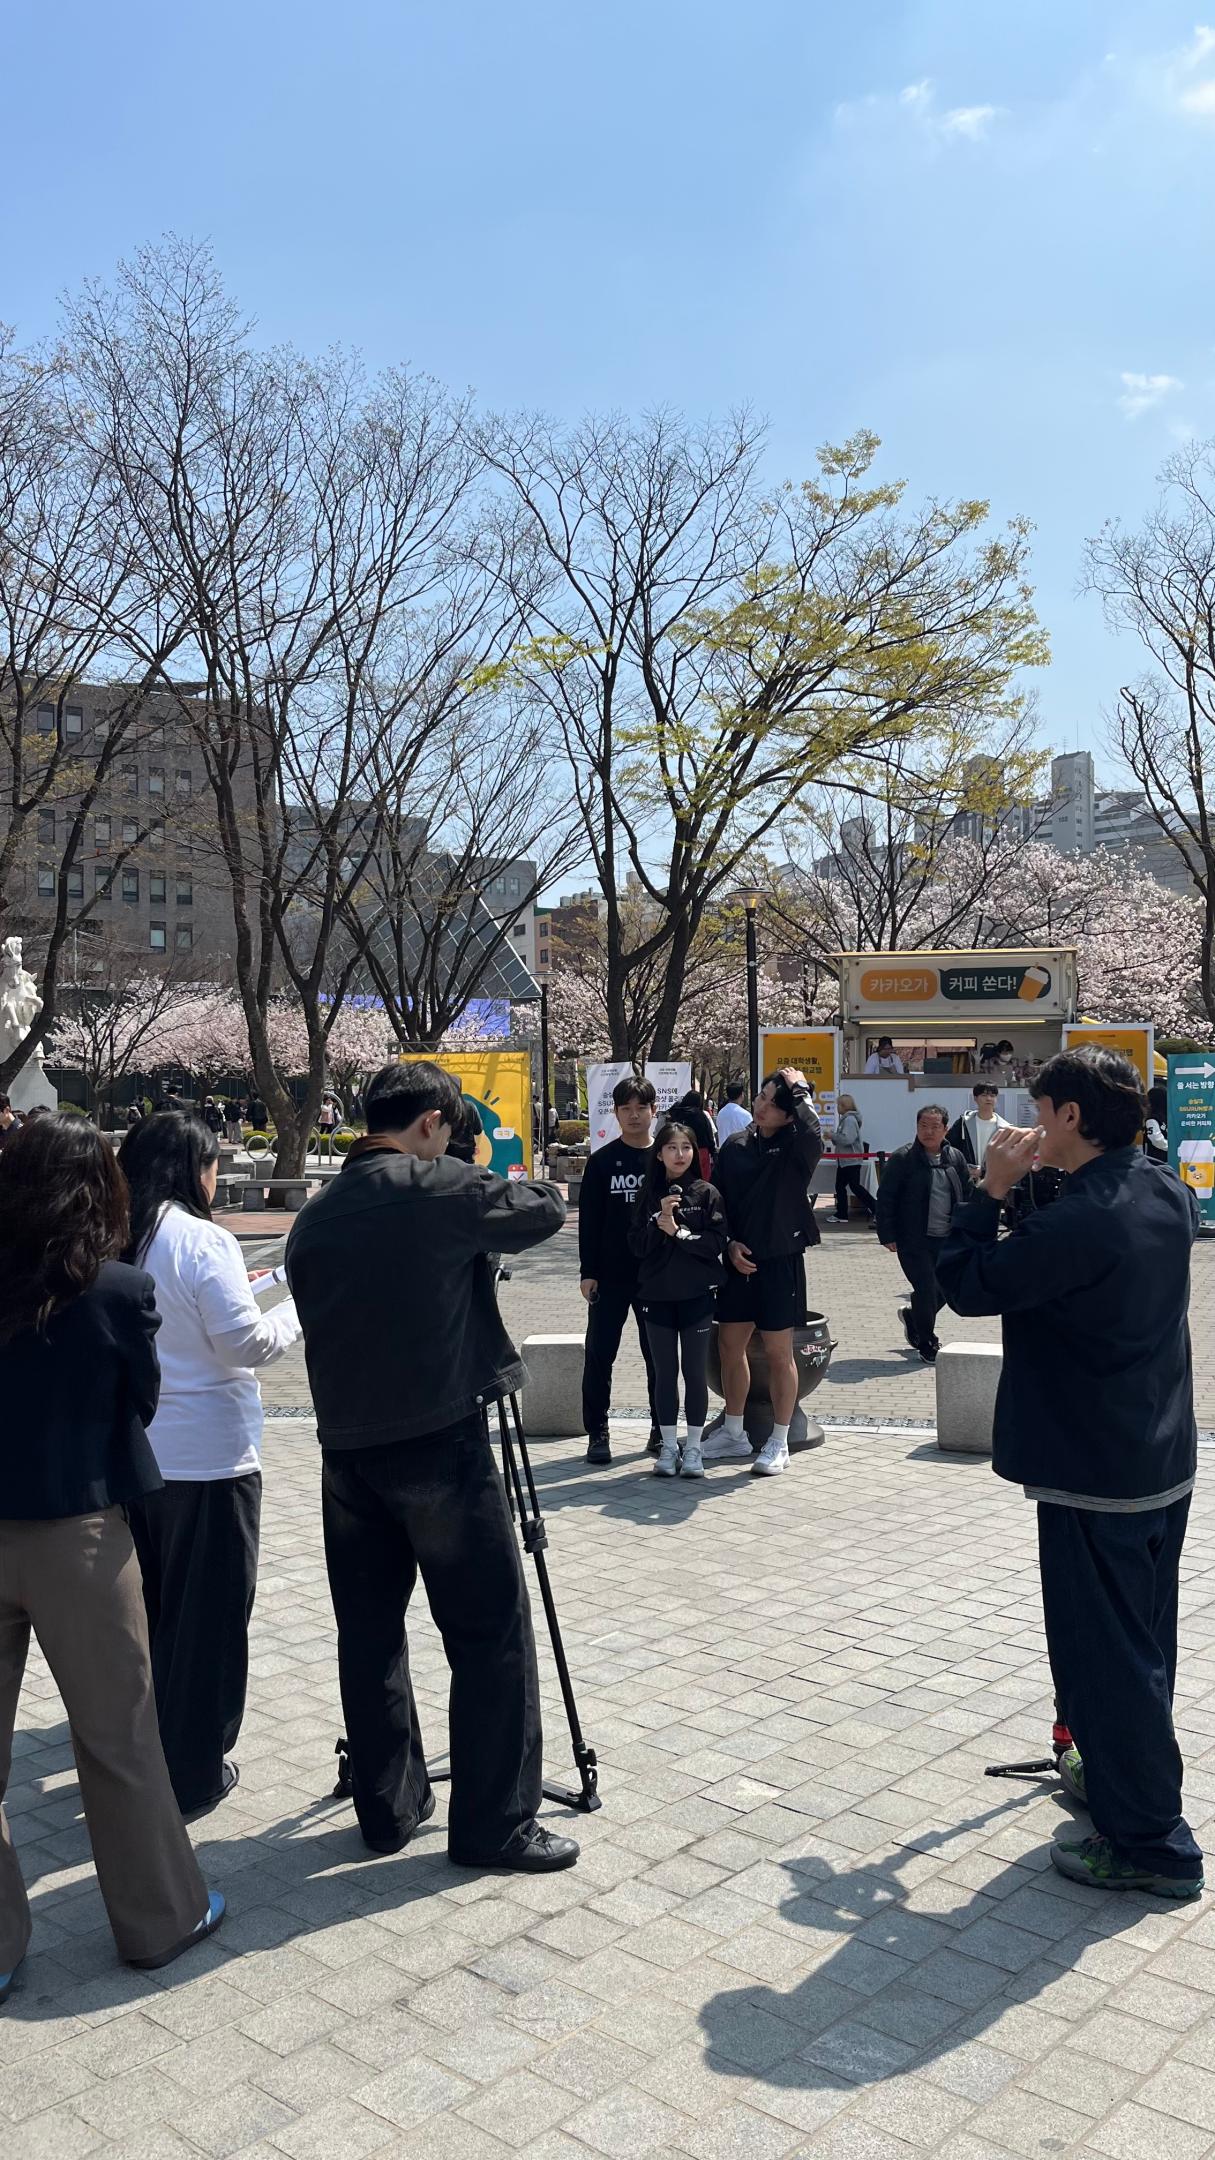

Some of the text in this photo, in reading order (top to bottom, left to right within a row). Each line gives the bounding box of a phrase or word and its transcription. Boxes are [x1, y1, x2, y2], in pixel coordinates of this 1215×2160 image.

[870, 976, 929, 993] 카카오가
[949, 975, 1017, 992] 커피 쏜다!
[657, 1087, 678, 1095] SNS에
[1177, 1081, 1214, 1090] 줄 서는 방향
